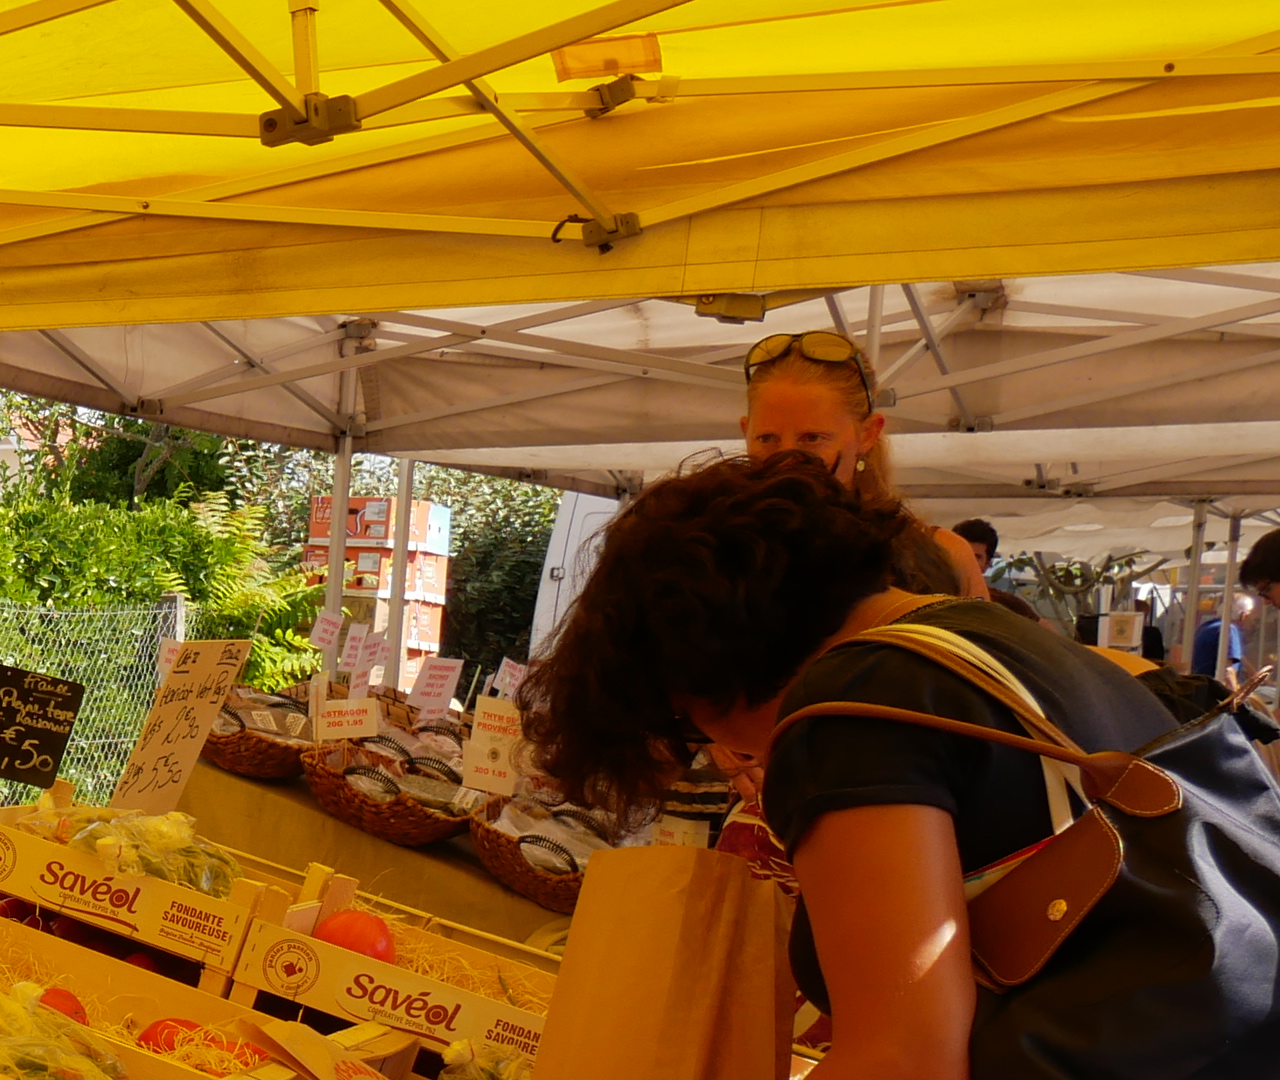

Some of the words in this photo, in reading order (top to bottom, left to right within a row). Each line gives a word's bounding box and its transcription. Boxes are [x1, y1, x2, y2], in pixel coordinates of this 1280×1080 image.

[24, 673, 72, 696] France
[326, 720, 343, 728] 20G
[345, 718, 364, 727] 1.95
[477, 721, 519, 736] PROVENCE
[482, 711, 505, 721] THYM
[506, 715, 518, 724] DE
[473, 765, 489, 775] 30G
[491, 768, 507, 778] 1.95
[39, 860, 142, 915] Savéol
[169, 900, 226, 928] FONDANTE
[161, 910, 231, 943] SAVOUREUSE
[286, 942, 315, 963] passion
[345, 973, 463, 1033] Savéol
